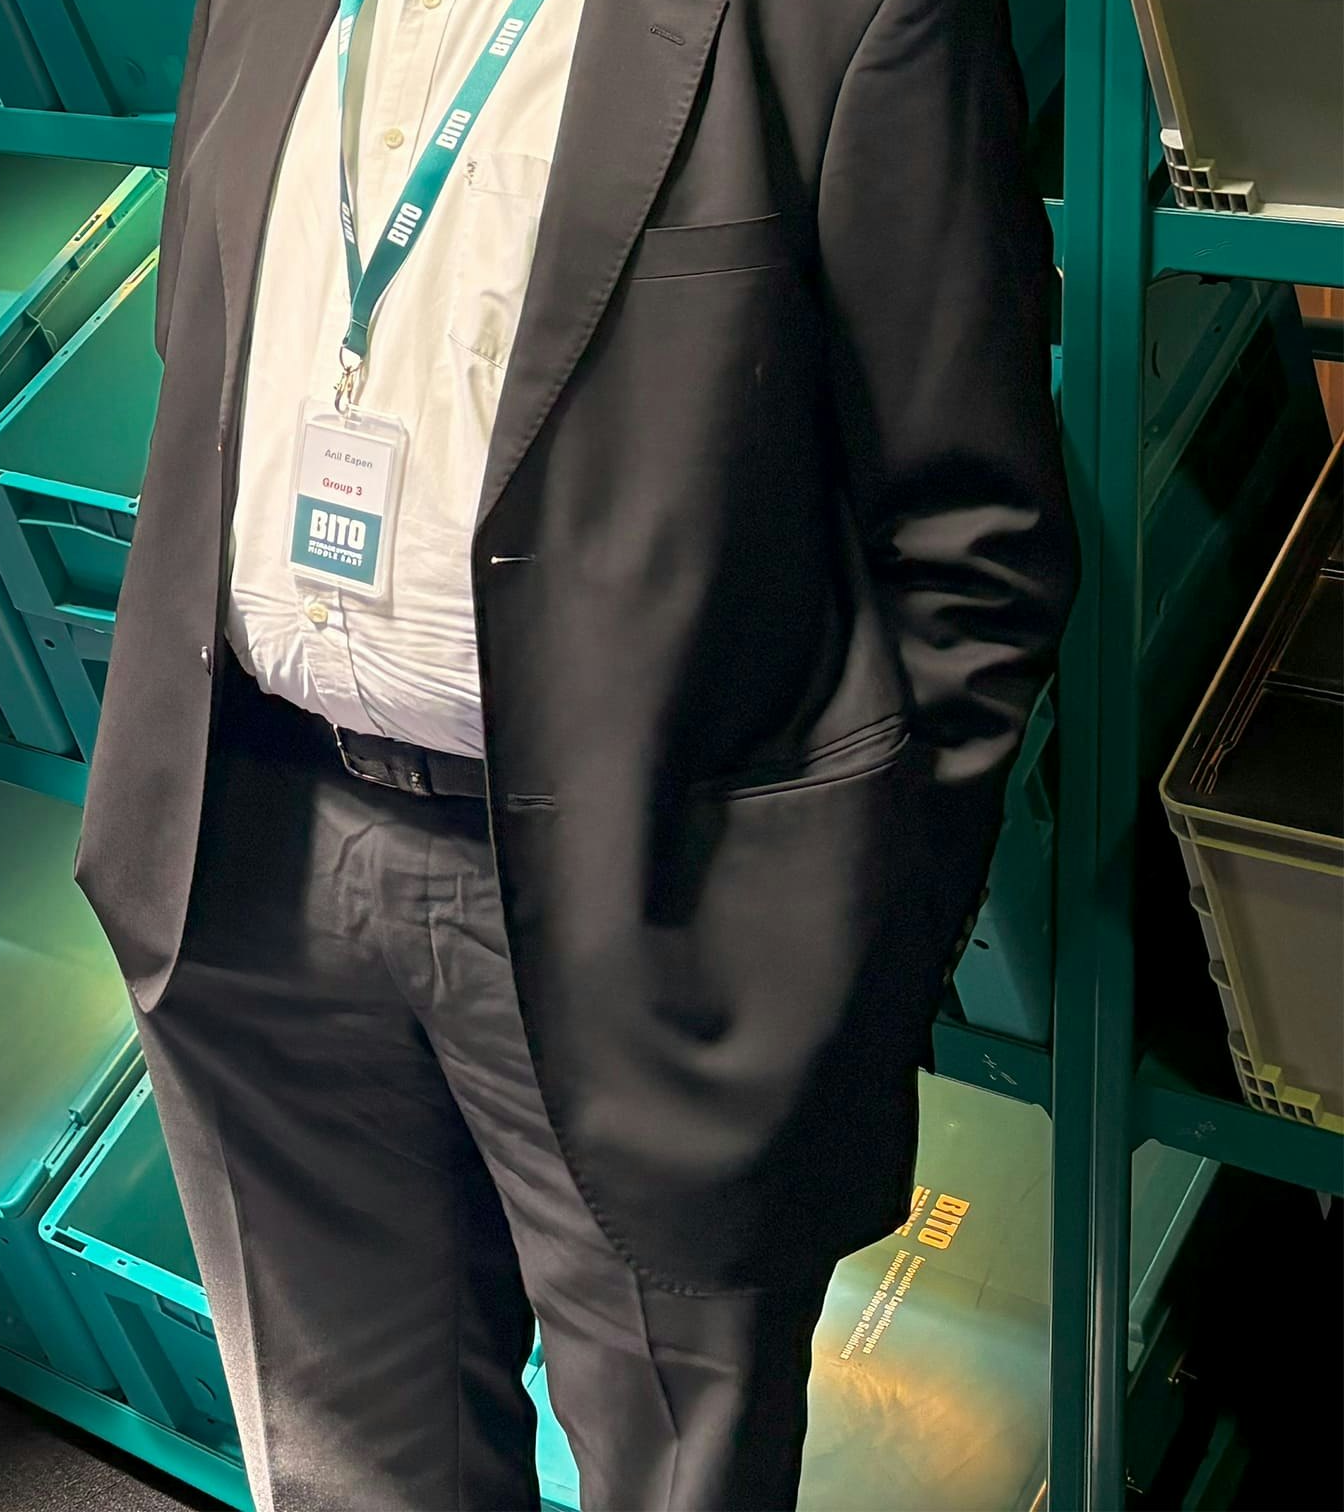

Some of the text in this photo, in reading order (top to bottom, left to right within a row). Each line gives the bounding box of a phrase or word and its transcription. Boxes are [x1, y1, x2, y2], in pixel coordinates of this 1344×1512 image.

[488, 17, 525, 57] BITO
[435, 108, 472, 151] BITO
[387, 201, 423, 248] BITO
[325, 449, 342, 461] Anil
[322, 477, 363, 497] Group 3
[310, 508, 366, 550] BITO
[917, 1193, 970, 1250] BITO
[897, 1255, 926, 1298] Innovative
[839, 1249, 911, 1361] Innovative Storage Solutions
